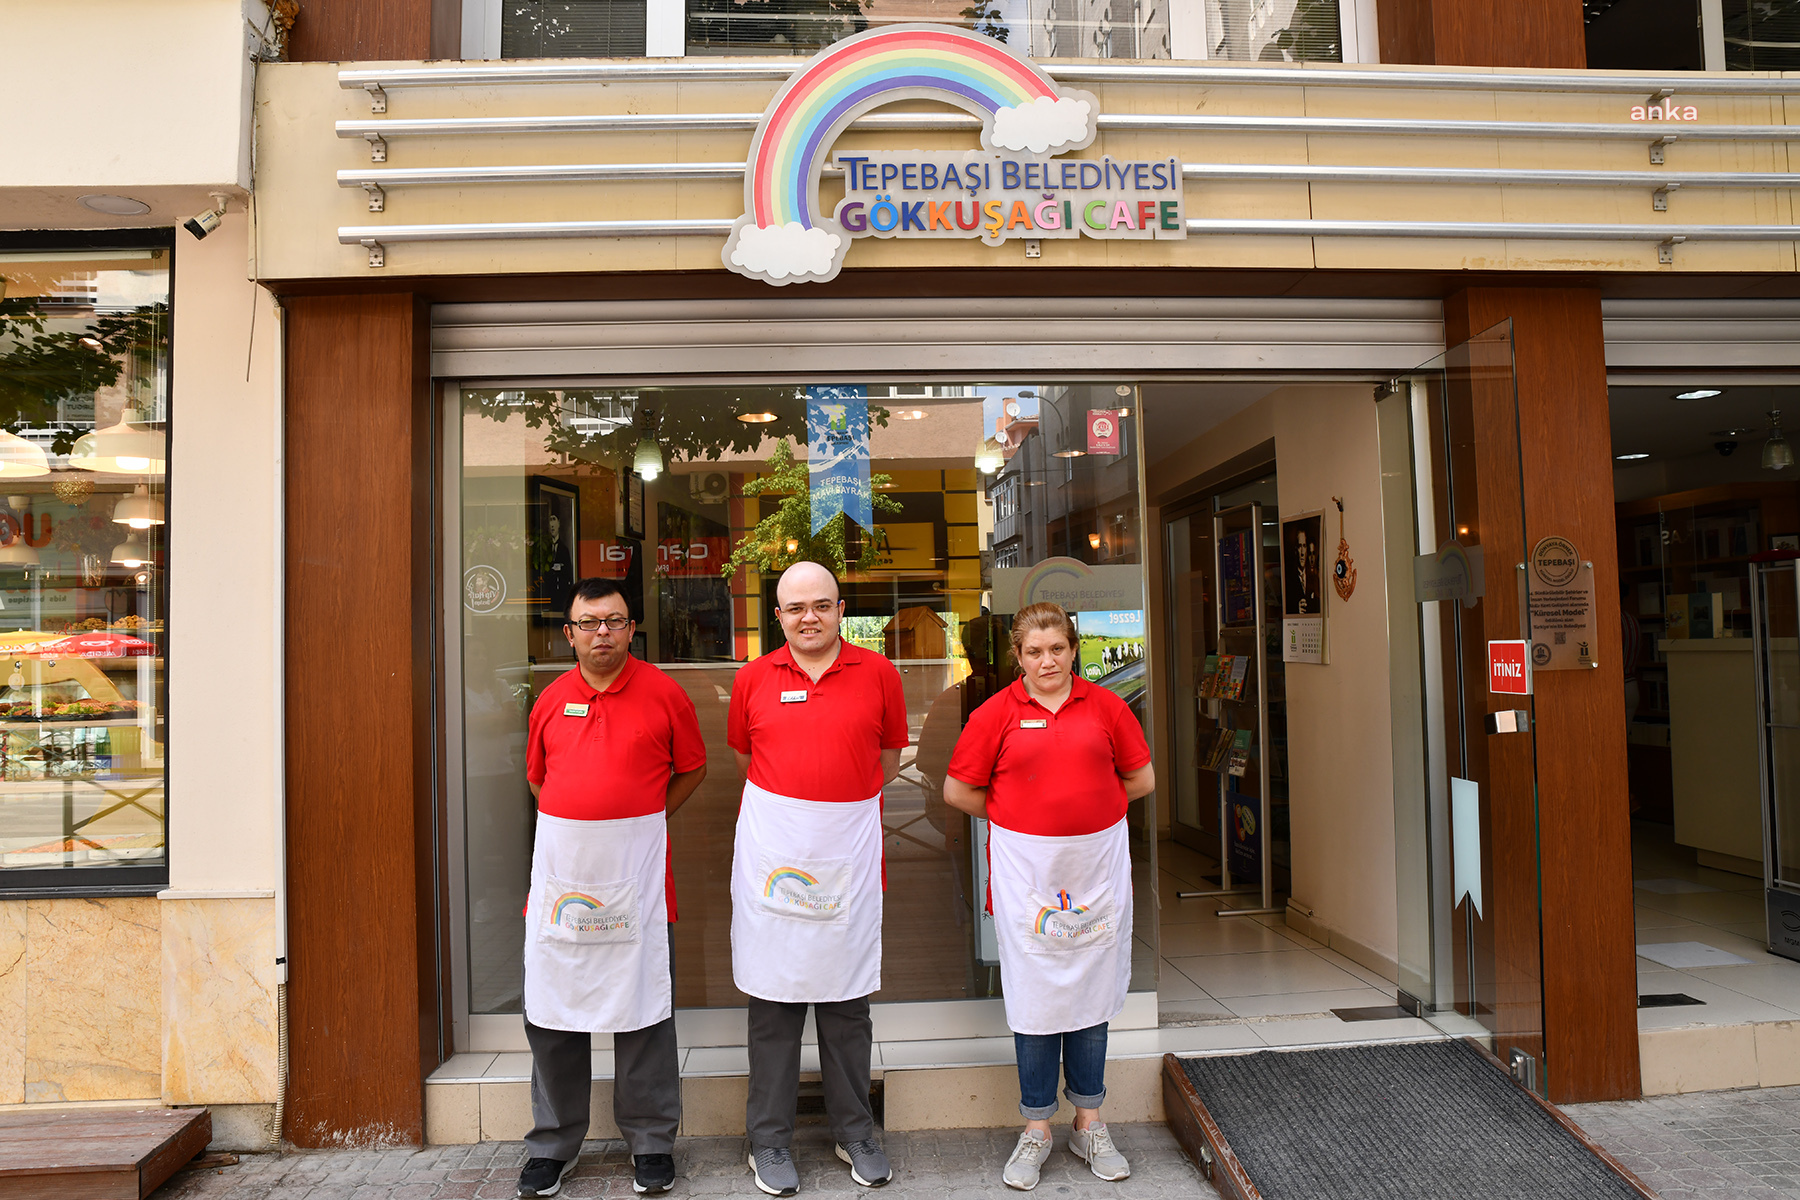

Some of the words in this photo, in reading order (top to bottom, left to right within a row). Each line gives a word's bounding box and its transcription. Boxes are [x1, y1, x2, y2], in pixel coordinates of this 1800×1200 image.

[838, 157, 990, 197] TEPEBAŞI
[1002, 157, 1177, 191] BELEDİYESİ
[840, 193, 1073, 239] GÖKKUŞAĞI
[1083, 199, 1180, 231] CAFE
[820, 475, 862, 487] TEPEBAŞI
[1538, 558, 1575, 567] TEPEBAŞI
[1040, 589, 1078, 600] TEPEBAŞI
[1493, 658, 1522, 678] İTİNİZ
[778, 896, 822, 910] GÖKKUŞAĞI
[823, 902, 842, 910] CAFE
[808, 894, 843, 903] BELEDİYESİ
[593, 914, 629, 925] BELEDİYESİ
[565, 922, 609, 932] GÖKKUŞAĞI
[609, 921, 630, 930] CAFE
[1092, 922, 1111, 932] CAFE
